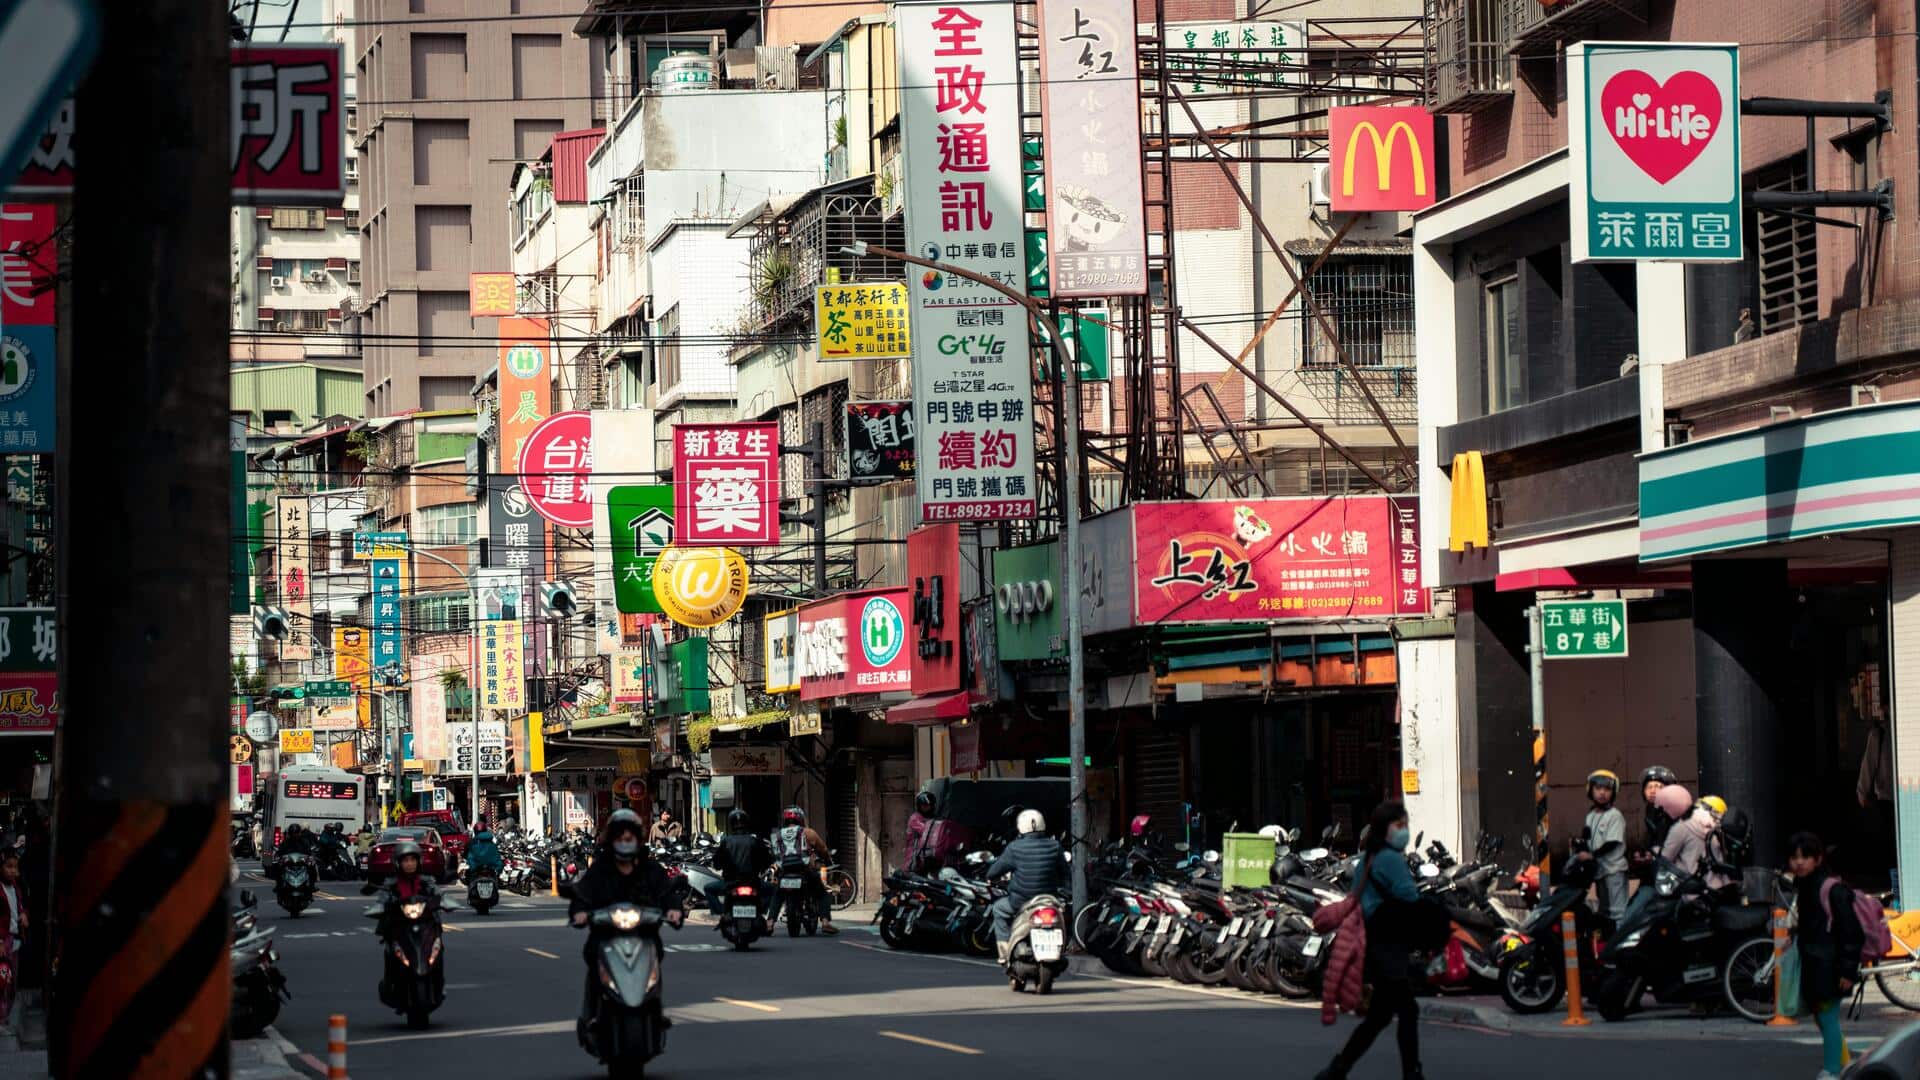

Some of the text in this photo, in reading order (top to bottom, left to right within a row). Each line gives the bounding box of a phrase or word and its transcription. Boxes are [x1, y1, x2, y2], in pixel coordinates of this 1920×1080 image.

[1060, 8, 1119, 79] 上紅
[931, 8, 992, 232] 全政通訊
[1615, 93, 1711, 146] Hi-Life
[1597, 212, 1730, 248] 萊爾富
[945, 242, 1016, 259] 中華電信
[824, 311, 851, 344] 茶
[934, 380, 985, 394] 台灣之星
[961, 370, 984, 378] STAR
[927, 399, 1024, 424] 門號申辦
[684, 429, 771, 457] 新資生
[938, 429, 1017, 471] 續約
[695, 467, 761, 533] 藥
[933, 476, 1026, 498] 門號攜碼
[928, 503, 1032, 519] TEL:8982-1234
[1279, 530, 1369, 557] 小火鍋
[1398, 507, 1419, 607] 三重五華店
[1152, 538, 1259, 599] 上紅
[711, 561, 743, 619] TRUE IN
[1545, 606, 1611, 627] 五華街
[1557, 631, 1611, 651] 87 巷
